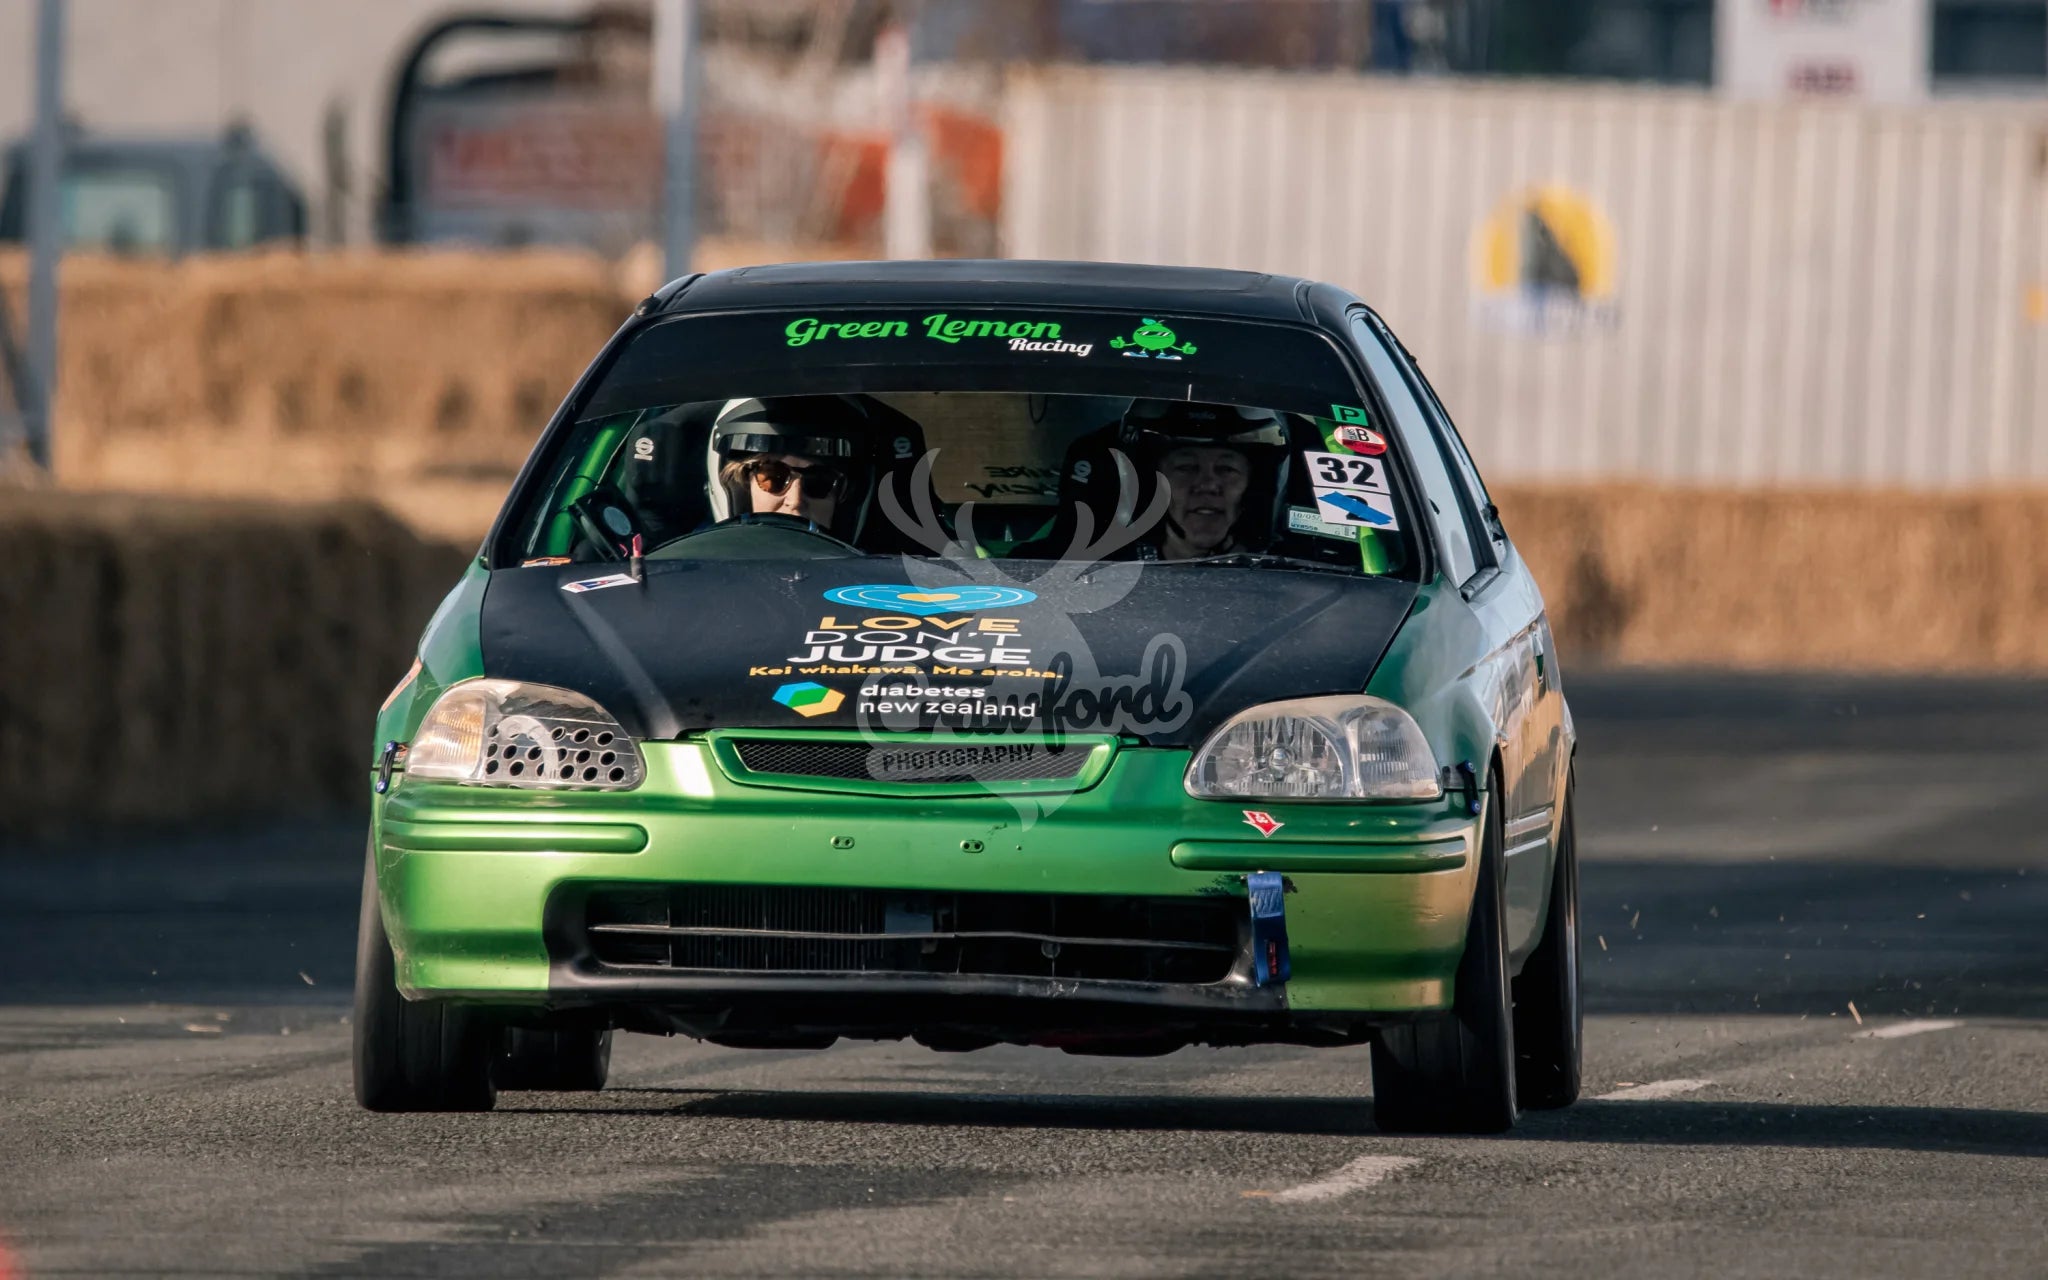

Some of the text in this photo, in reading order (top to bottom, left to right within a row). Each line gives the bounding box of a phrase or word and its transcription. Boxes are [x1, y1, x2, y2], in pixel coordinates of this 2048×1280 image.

[785, 313, 1062, 347] Green Lemon
[1008, 337, 1093, 357] Racing
[1339, 408, 1360, 421] P
[1355, 428, 1370, 442] B
[1316, 456, 1379, 488] 32
[819, 616, 1021, 632] LOVE
[804, 631, 1022, 646] DON'T
[786, 645, 1032, 665] JUDGE
[933, 666, 974, 676] Me
[981, 667, 1064, 679] aroha.
[859, 684, 986, 698] diabetes
[859, 700, 1036, 718] new zealand
